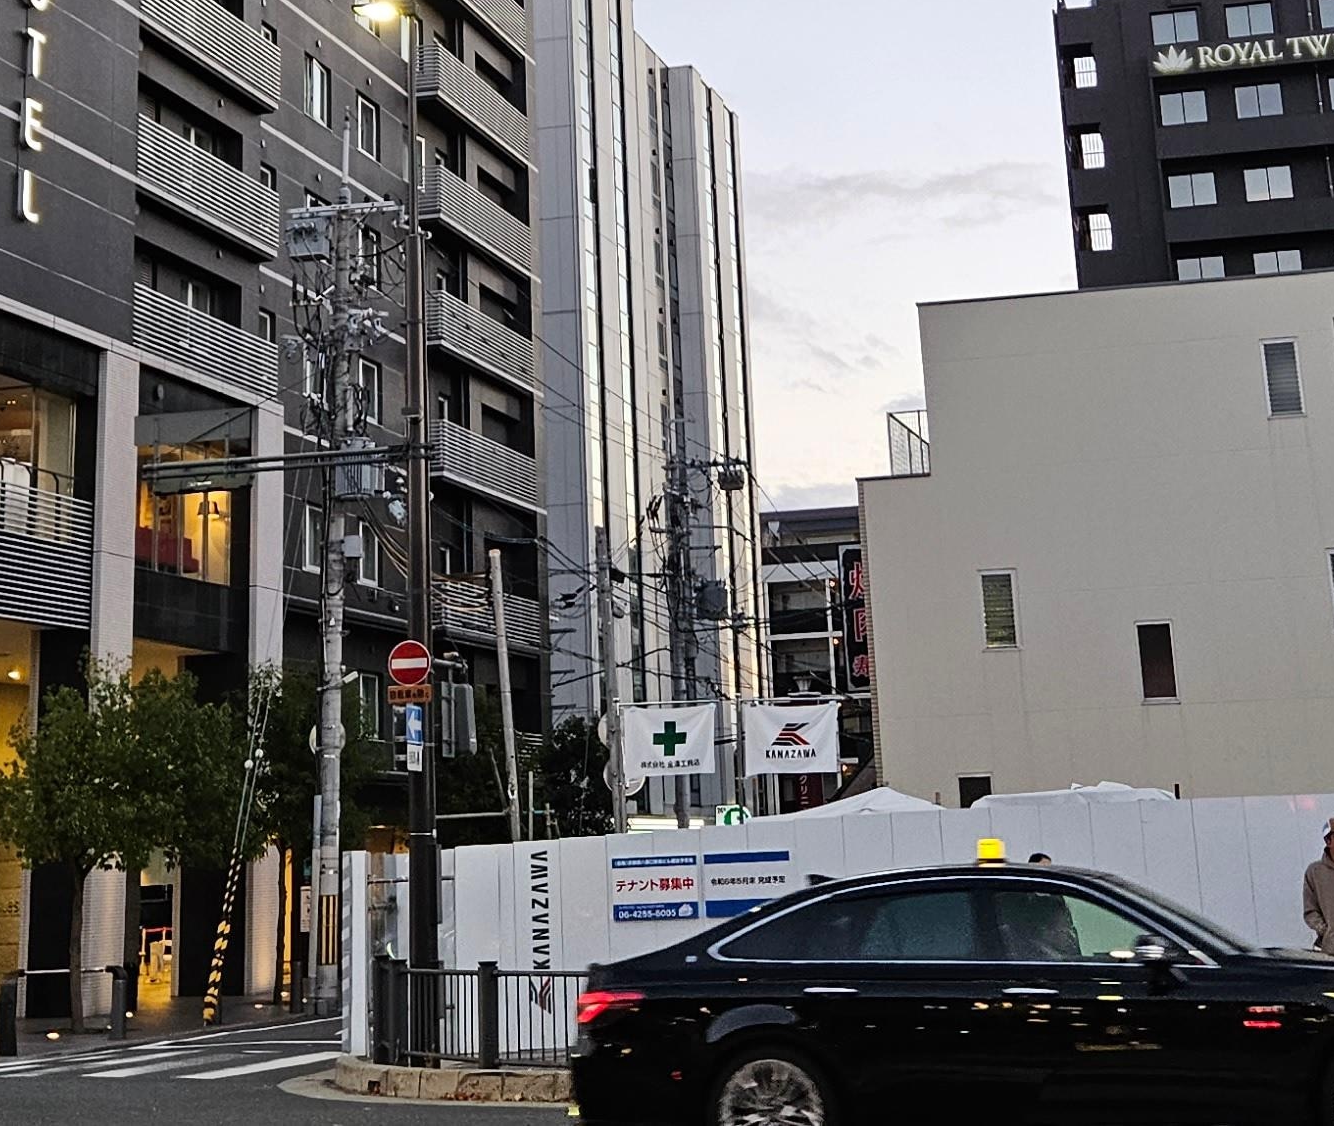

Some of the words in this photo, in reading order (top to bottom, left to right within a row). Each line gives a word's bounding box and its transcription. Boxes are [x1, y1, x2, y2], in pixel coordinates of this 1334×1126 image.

[1197, 40, 1284, 69] ROYAL
[765, 748, 817, 760] KANAZAWA
[616, 877, 695, 893] テナント募集中
[530, 850, 551, 970] KANAZAWA
